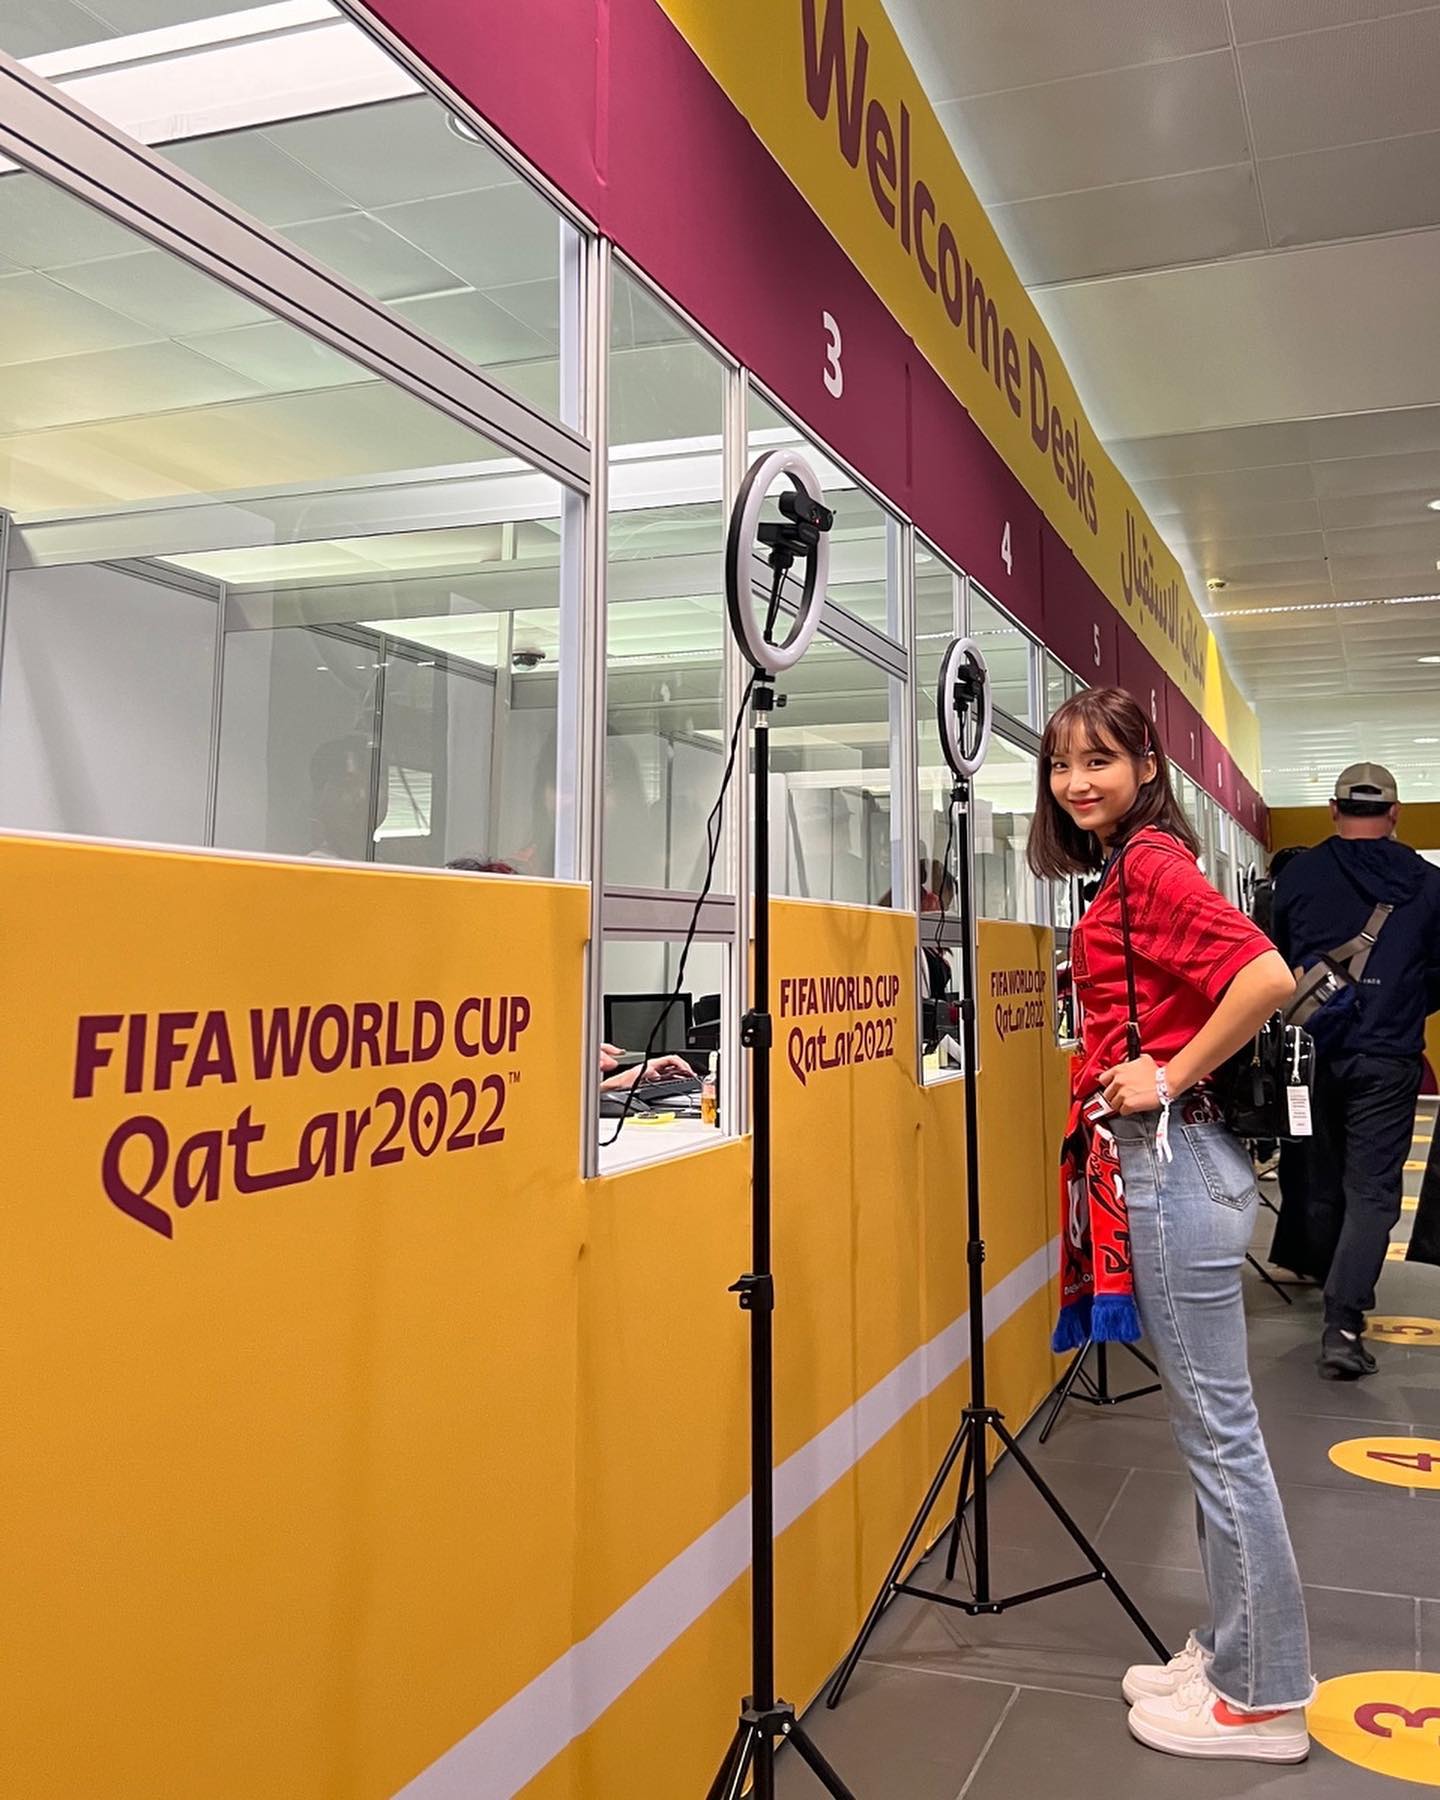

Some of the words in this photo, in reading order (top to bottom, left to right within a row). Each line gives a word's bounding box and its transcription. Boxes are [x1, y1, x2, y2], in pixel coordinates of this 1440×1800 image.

[800, 0, 1021, 418] Welcome
[1028, 338, 1098, 536] Desks
[822, 310, 843, 399] 3
[1001, 521, 1012, 576] 4
[1120, 508, 1178, 650] الاستقبال
[1094, 623, 1101, 667] 5
[780, 977, 819, 1018] FIFA
[819, 975, 874, 1015] WORLD
[875, 974, 900, 1010] CUP
[72, 1010, 238, 1100] FIFA
[249, 1000, 445, 1082] WORLD
[454, 996, 532, 1063] CUP
[1372, 1323, 1434, 1336] 5
[1366, 1450, 1440, 1473] 4
[1353, 1702, 1440, 1747] 3
